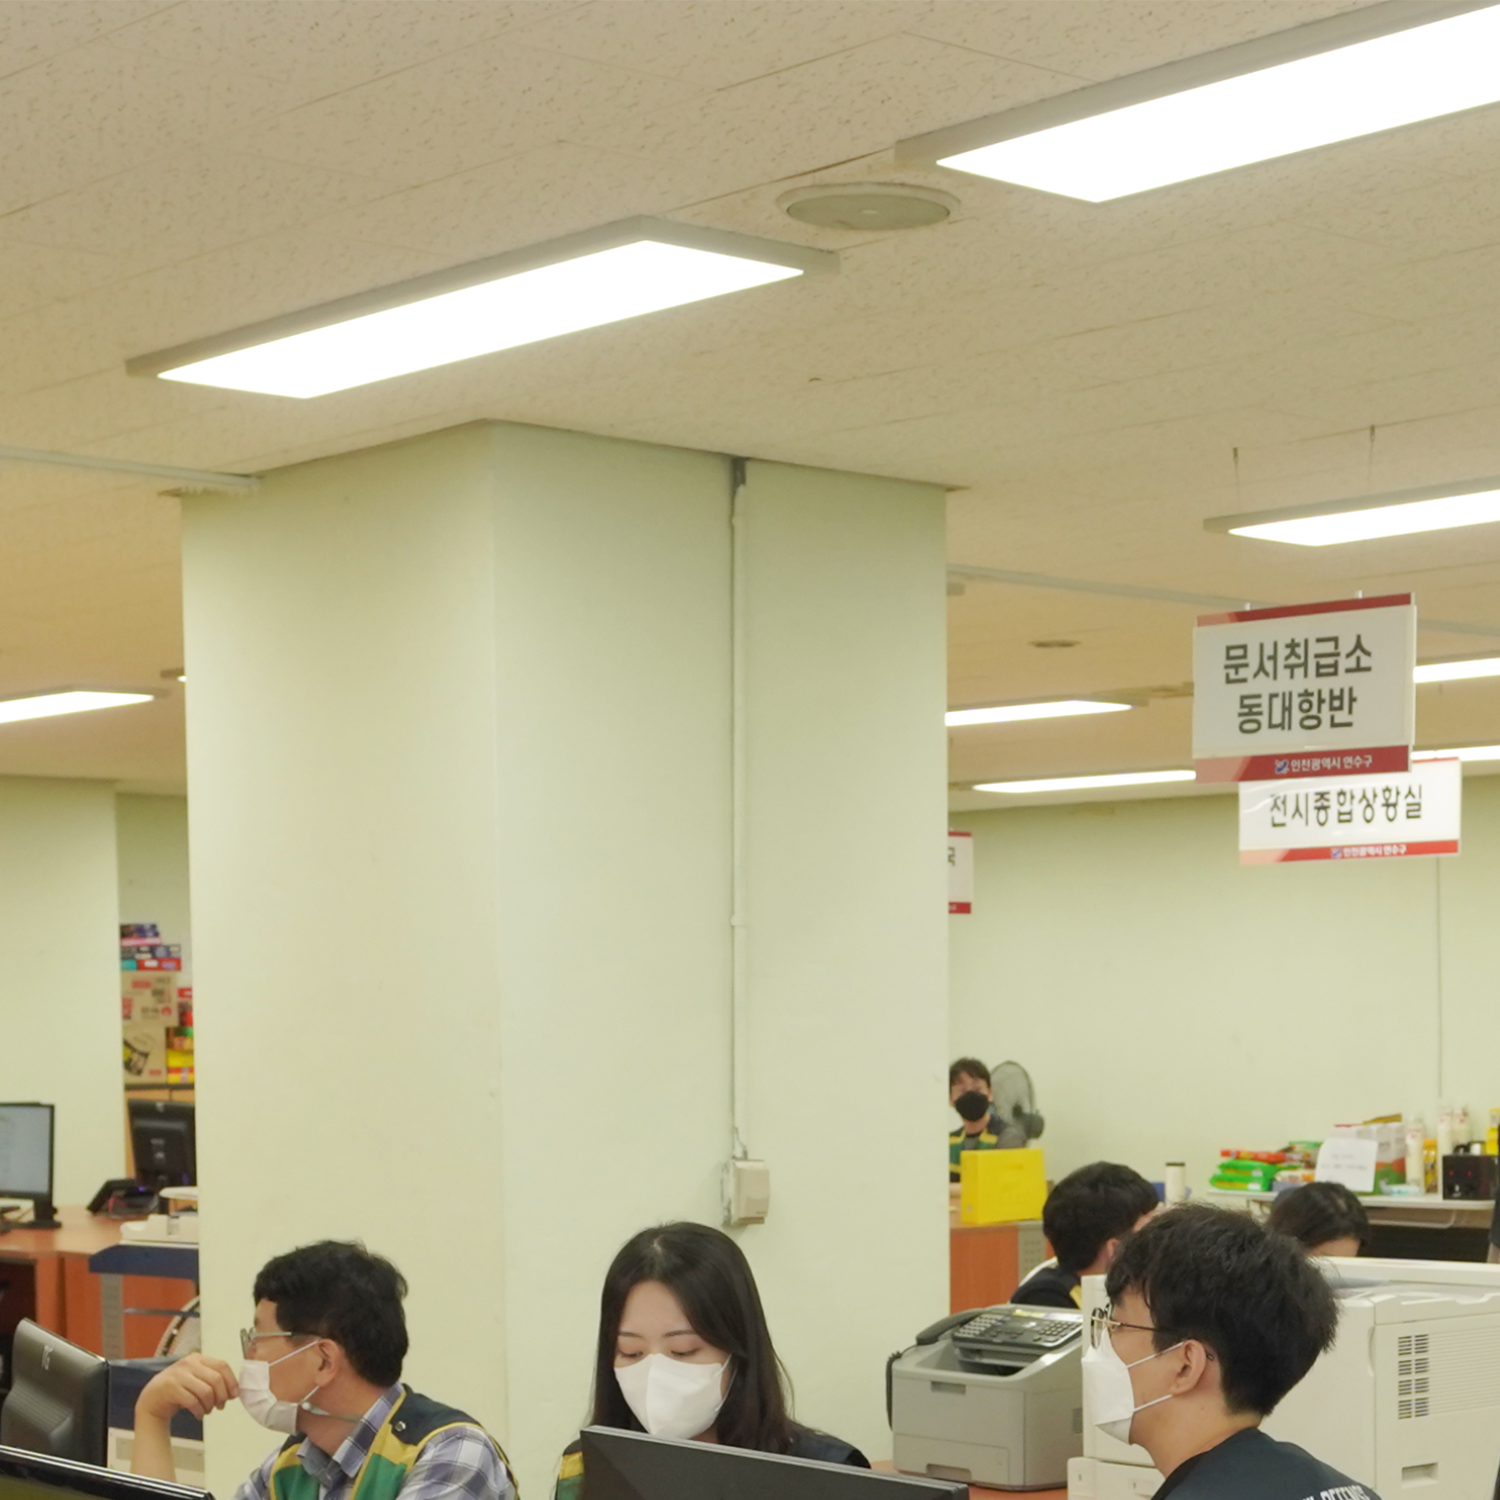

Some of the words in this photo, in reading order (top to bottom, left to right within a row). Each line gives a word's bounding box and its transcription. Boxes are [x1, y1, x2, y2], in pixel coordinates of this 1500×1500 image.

[1223, 634, 1372, 685] 문서취급소
[1237, 687, 1357, 734] 동대항반
[1269, 784, 1423, 828] 전시종합상황실
